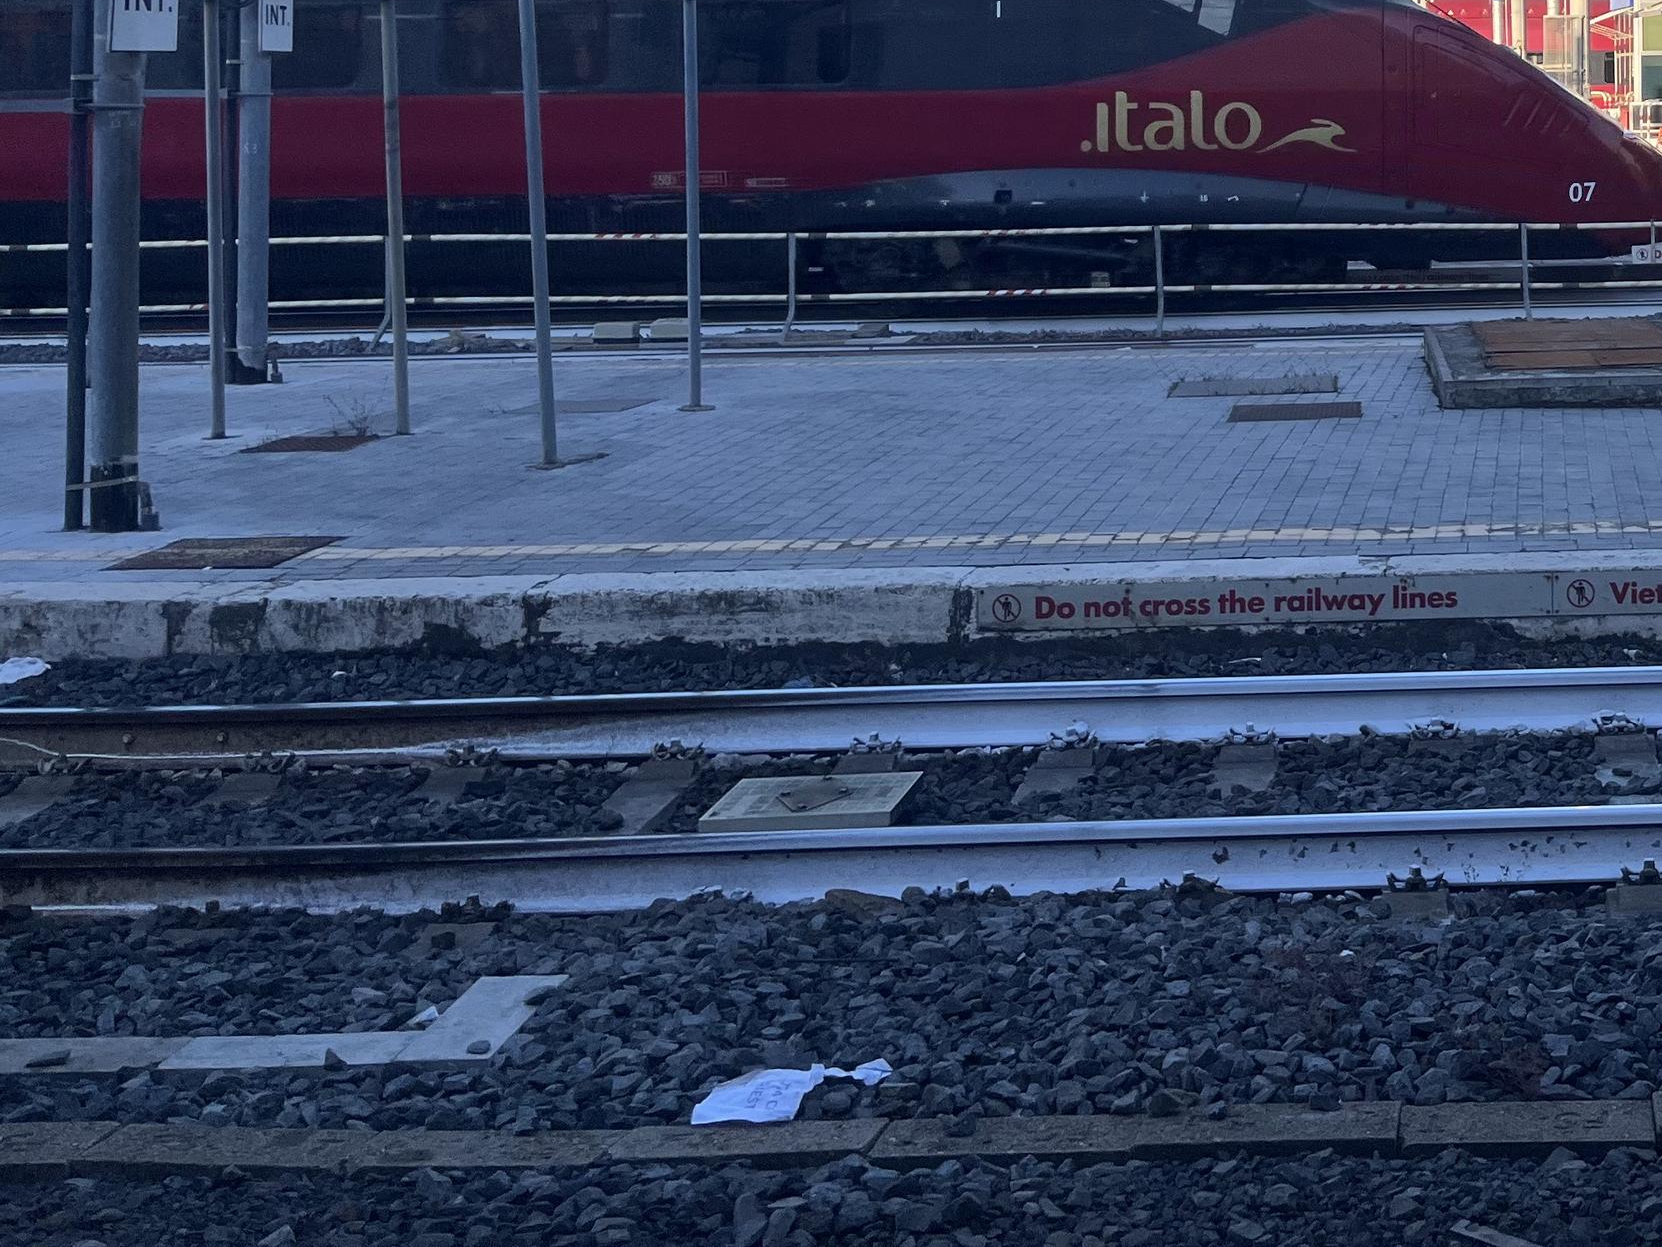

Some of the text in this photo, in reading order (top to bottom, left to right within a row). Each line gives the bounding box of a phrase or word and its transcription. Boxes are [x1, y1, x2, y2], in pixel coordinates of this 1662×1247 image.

[265, 4, 290, 27] INT.
[1568, 181, 1597, 203] 07
[1034, 584, 1458, 620] Do not cross the railway lines
